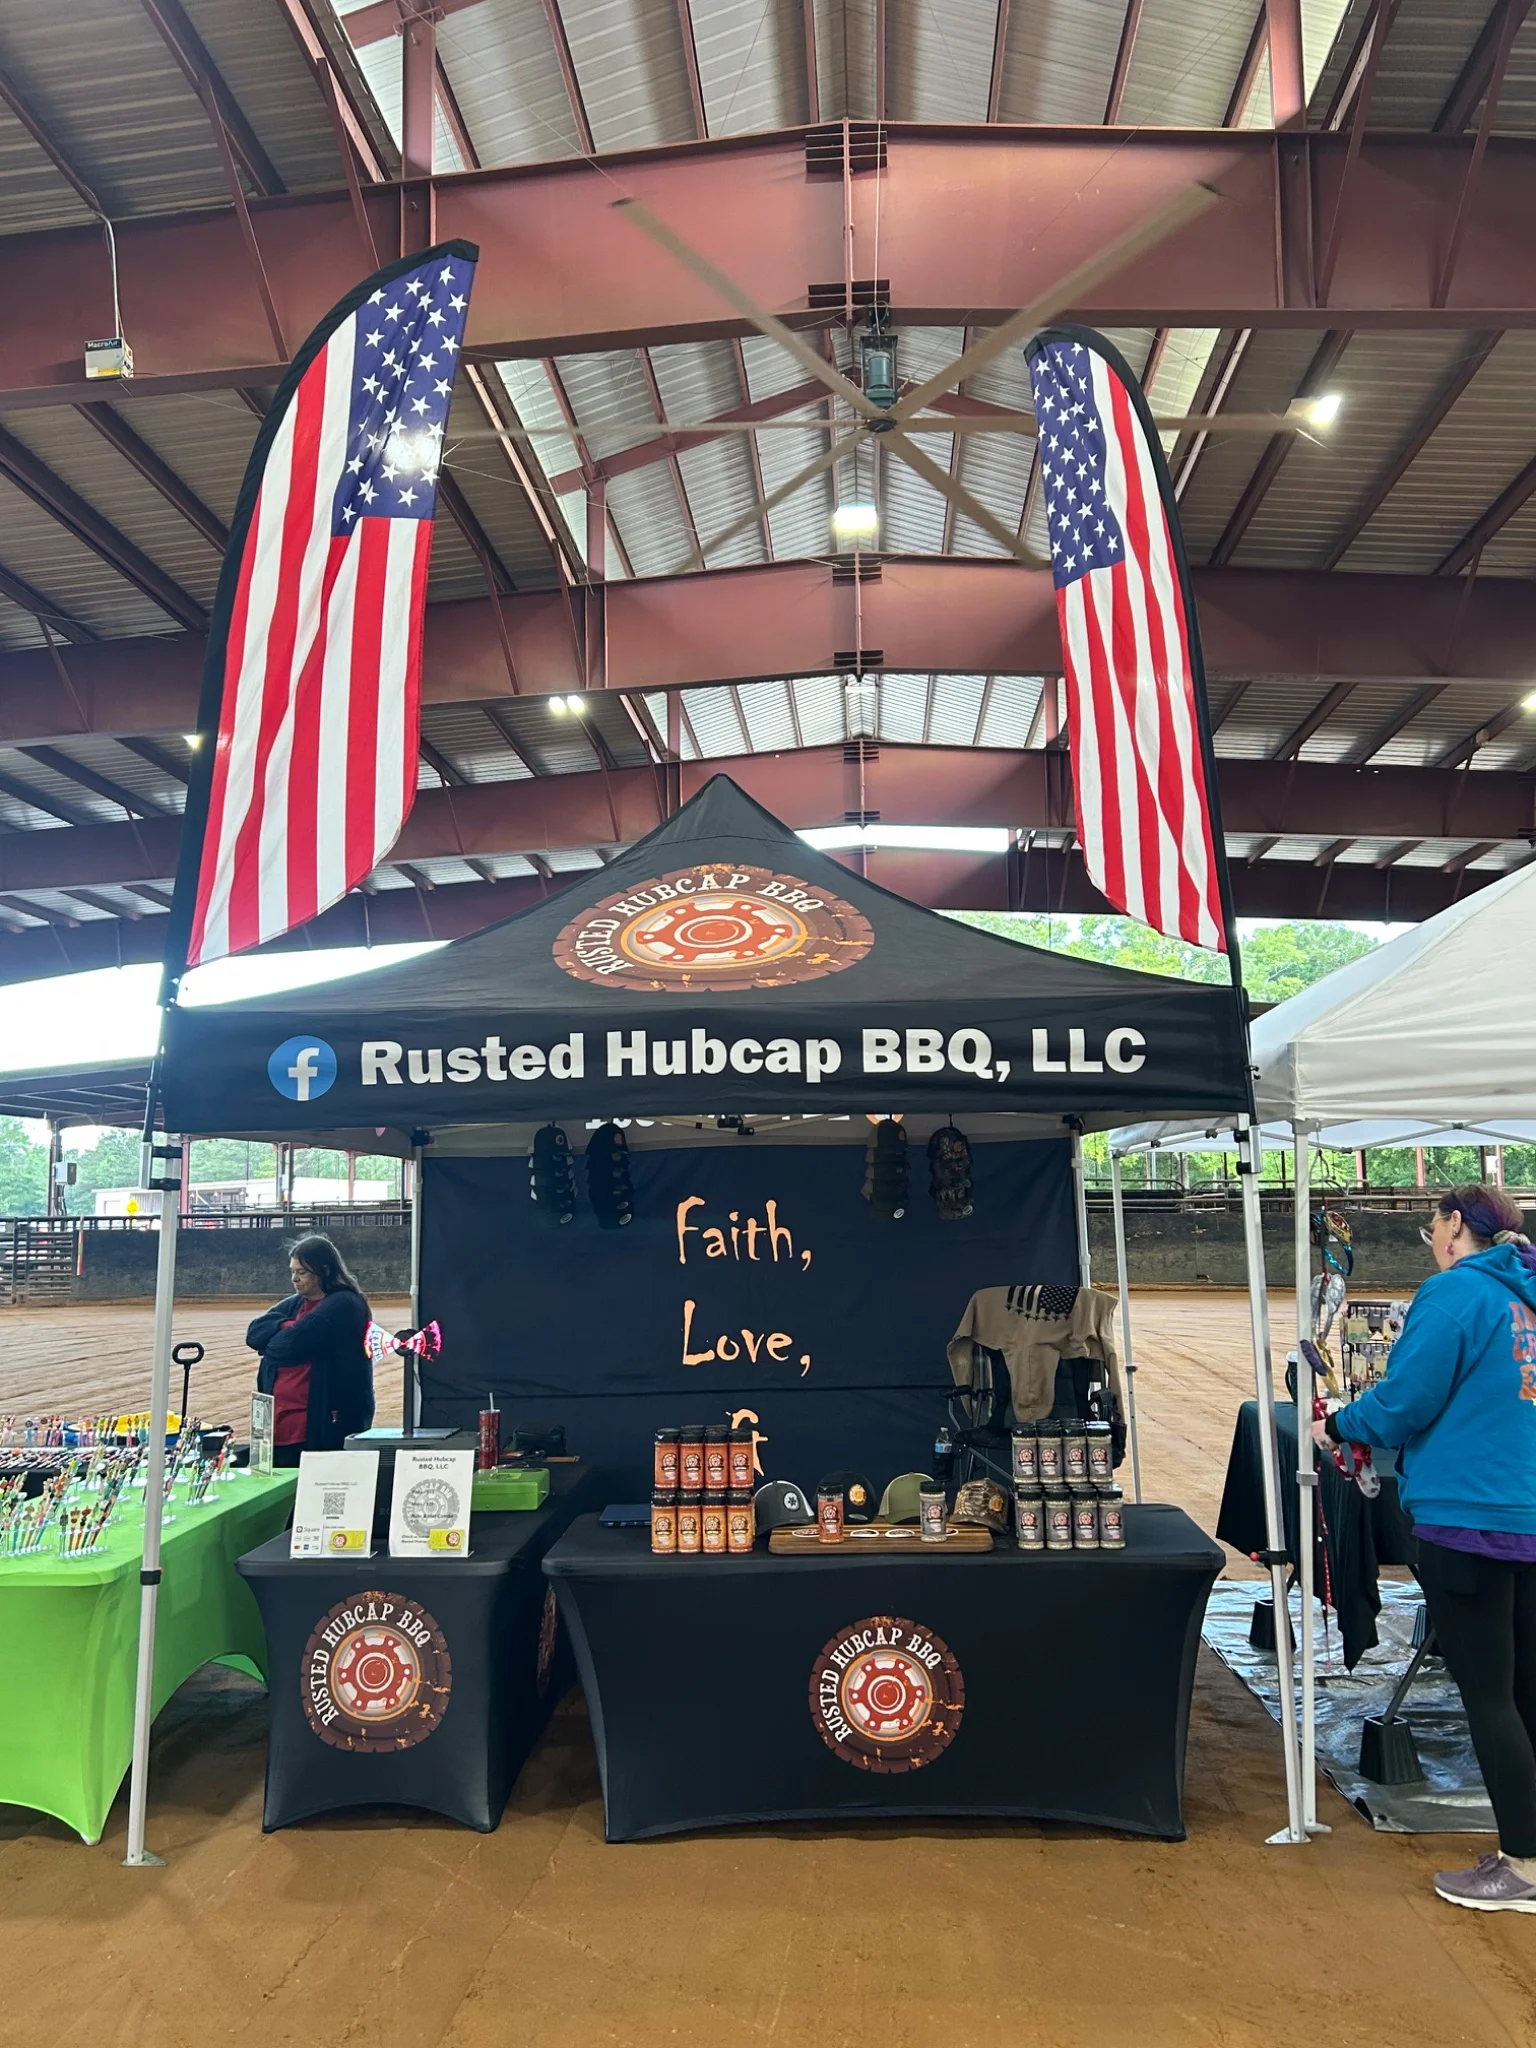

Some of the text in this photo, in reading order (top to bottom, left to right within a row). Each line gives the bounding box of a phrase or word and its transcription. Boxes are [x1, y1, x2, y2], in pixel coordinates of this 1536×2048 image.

[575, 873, 826, 975] RUSTED HUBCAP BBQ
[361, 1033, 585, 1086] Rusted
[606, 1028, 842, 1083] Hubcap
[862, 1028, 1011, 1082] BBQ,
[1031, 1027, 1146, 1074] LLC
[676, 1196, 812, 1271] Faith,
[682, 1299, 812, 1377] Love,
[434, 1456, 457, 1464] Hubcap
[310, 1601, 432, 1727] RUSTED HUBCAP BBQ
[819, 1627, 943, 1743] RUSTED HUBCAP BBQ
